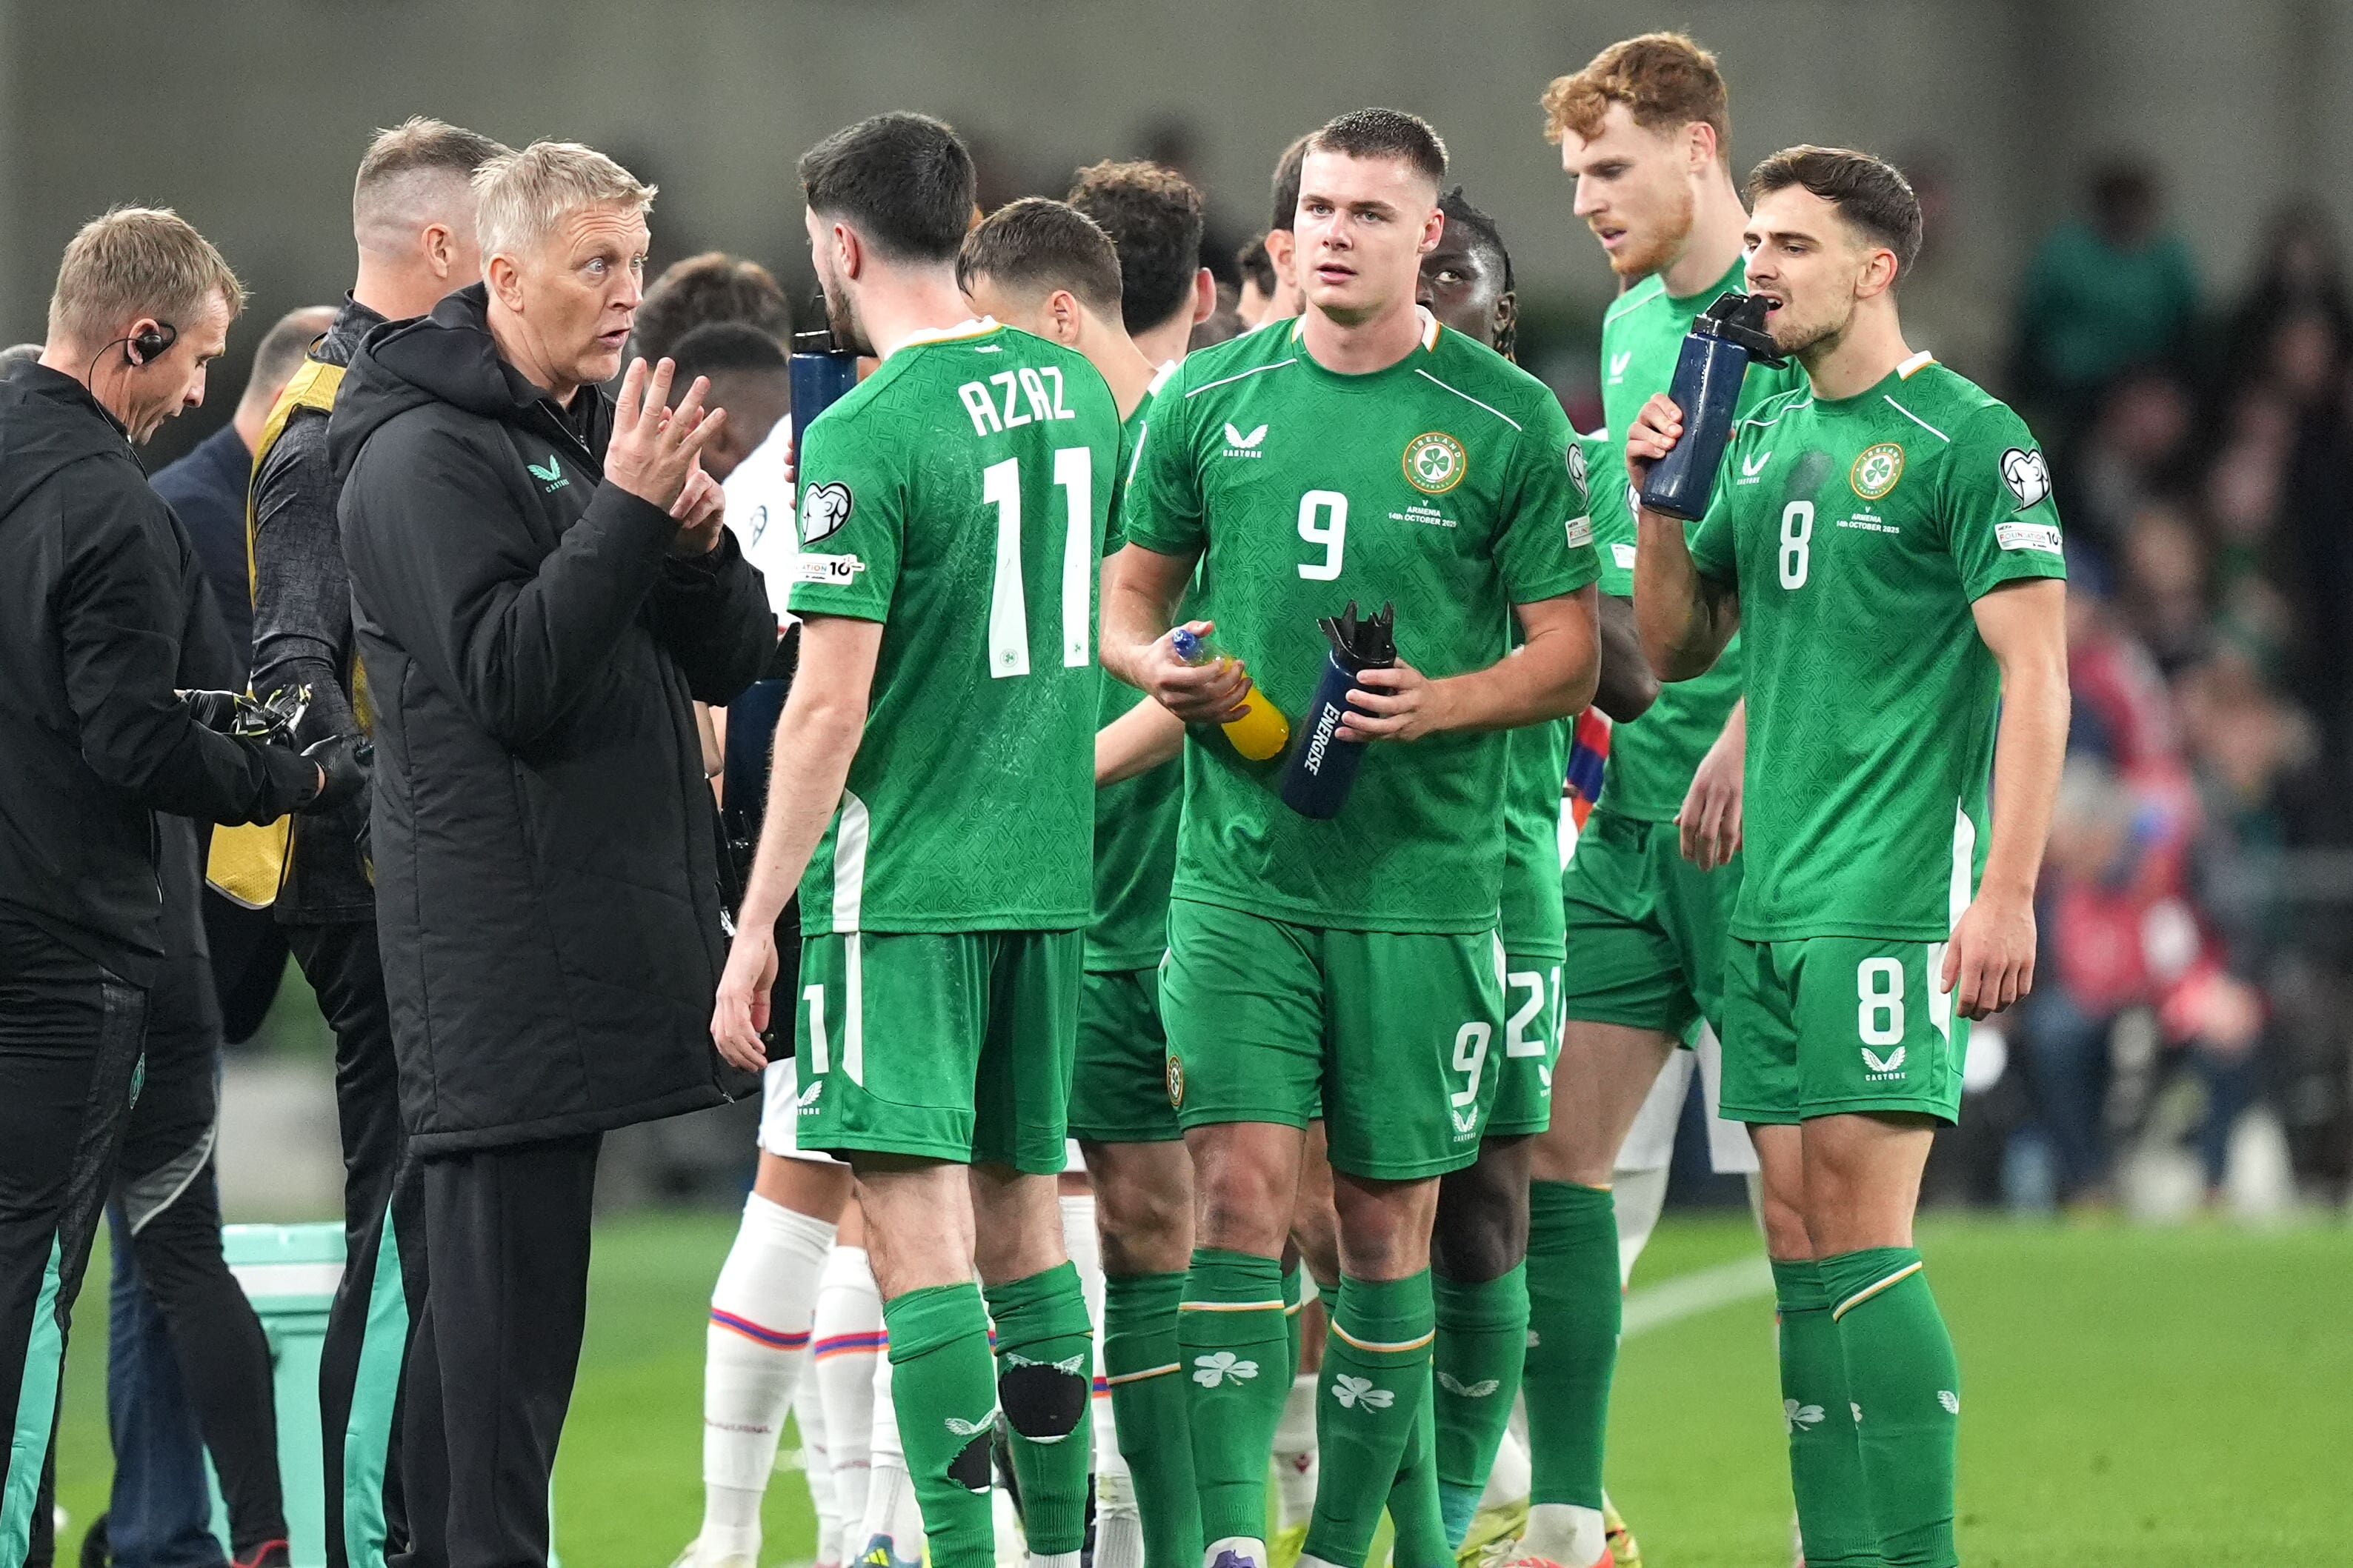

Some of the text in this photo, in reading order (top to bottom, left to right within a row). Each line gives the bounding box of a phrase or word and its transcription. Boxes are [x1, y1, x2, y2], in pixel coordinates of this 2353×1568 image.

[958, 366, 1076, 436] AZAZ
[1222, 449, 1262, 458] CASTORE
[1412, 436, 1461, 458] IRELAND
[1863, 447, 1900, 464] IRELAND
[1404, 513, 1441, 525] OCTOBER
[1406, 506, 1441, 517] ARMENIA
[1851, 513, 1882, 524] ARMENIA
[1297, 490, 1348, 581] 9
[1848, 521, 1882, 532] OCTOBER
[1882, 525, 1900, 533] 2025
[1999, 531, 2046, 541] FOUNATION
[1779, 501, 1814, 590] 8
[983, 446, 1091, 678] 11
[1304, 697, 1341, 776] ENERGISE
[1506, 966, 1560, 1058] 21
[1857, 957, 1905, 1046] 8
[1451, 1022, 1491, 1107] 9
[1865, 1072, 1906, 1081] CASTORE
